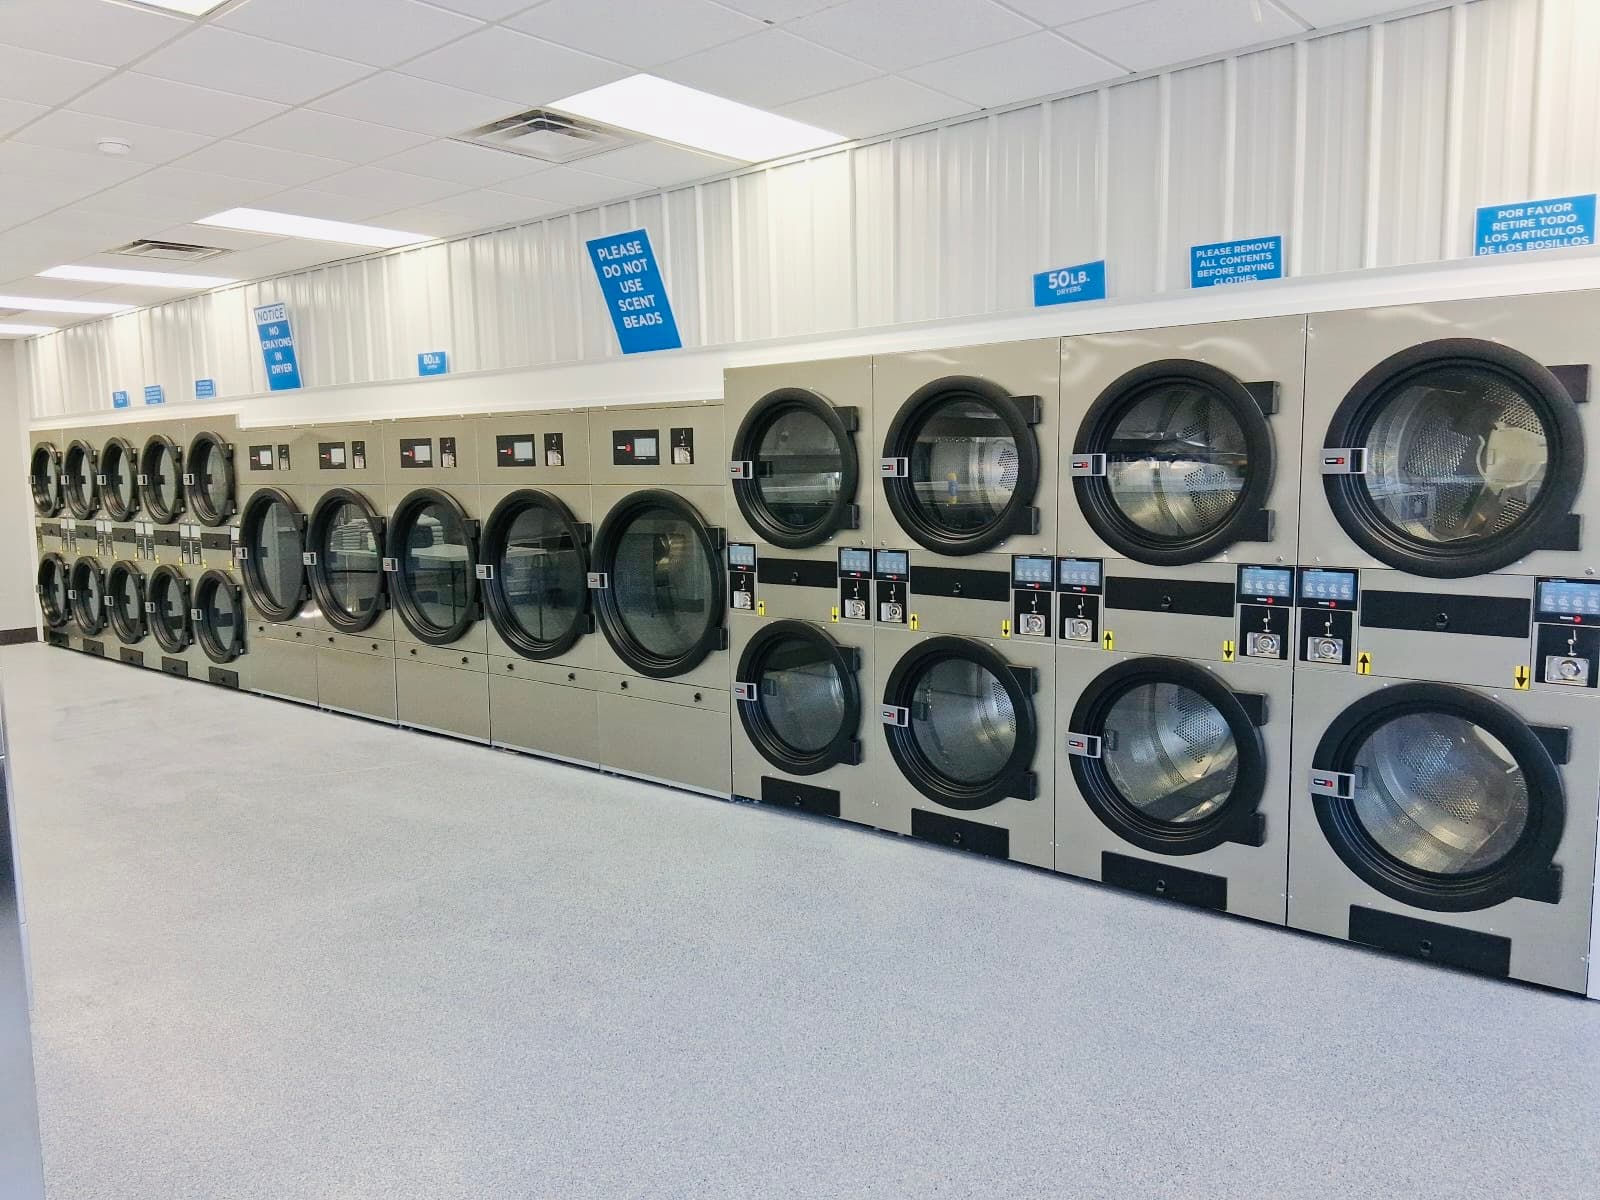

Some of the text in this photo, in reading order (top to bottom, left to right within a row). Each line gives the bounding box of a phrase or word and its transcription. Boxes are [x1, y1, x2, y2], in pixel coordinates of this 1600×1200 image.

[1498, 203, 1573, 219] POR FAVOR
[1492, 214, 1577, 231] RETIRE TODO
[1485, 225, 1584, 243] LOS ARTICULOS
[597, 240, 643, 261] PLEASE
[1196, 241, 1275, 258] PLEASE REMOVE
[1480, 236, 1589, 255] DE LOS BOSILLOS
[1200, 252, 1272, 267] ALL CONTENTS
[602, 258, 648, 278] DO NOT
[1197, 262, 1274, 277] BEFORE DRYING
[620, 278, 644, 293] USE
[1213, 274, 1258, 286] CLOTHES
[1057, 286, 1082, 295] DRYERS
[618, 295, 655, 311] SCENT
[257, 307, 284, 322] NOTICE
[623, 312, 663, 328] BEADS
[269, 326, 279, 336] NO
[262, 337, 292, 350] CRAYONS
[274, 352, 282, 360] IN
[271, 363, 292, 374] DRYER
